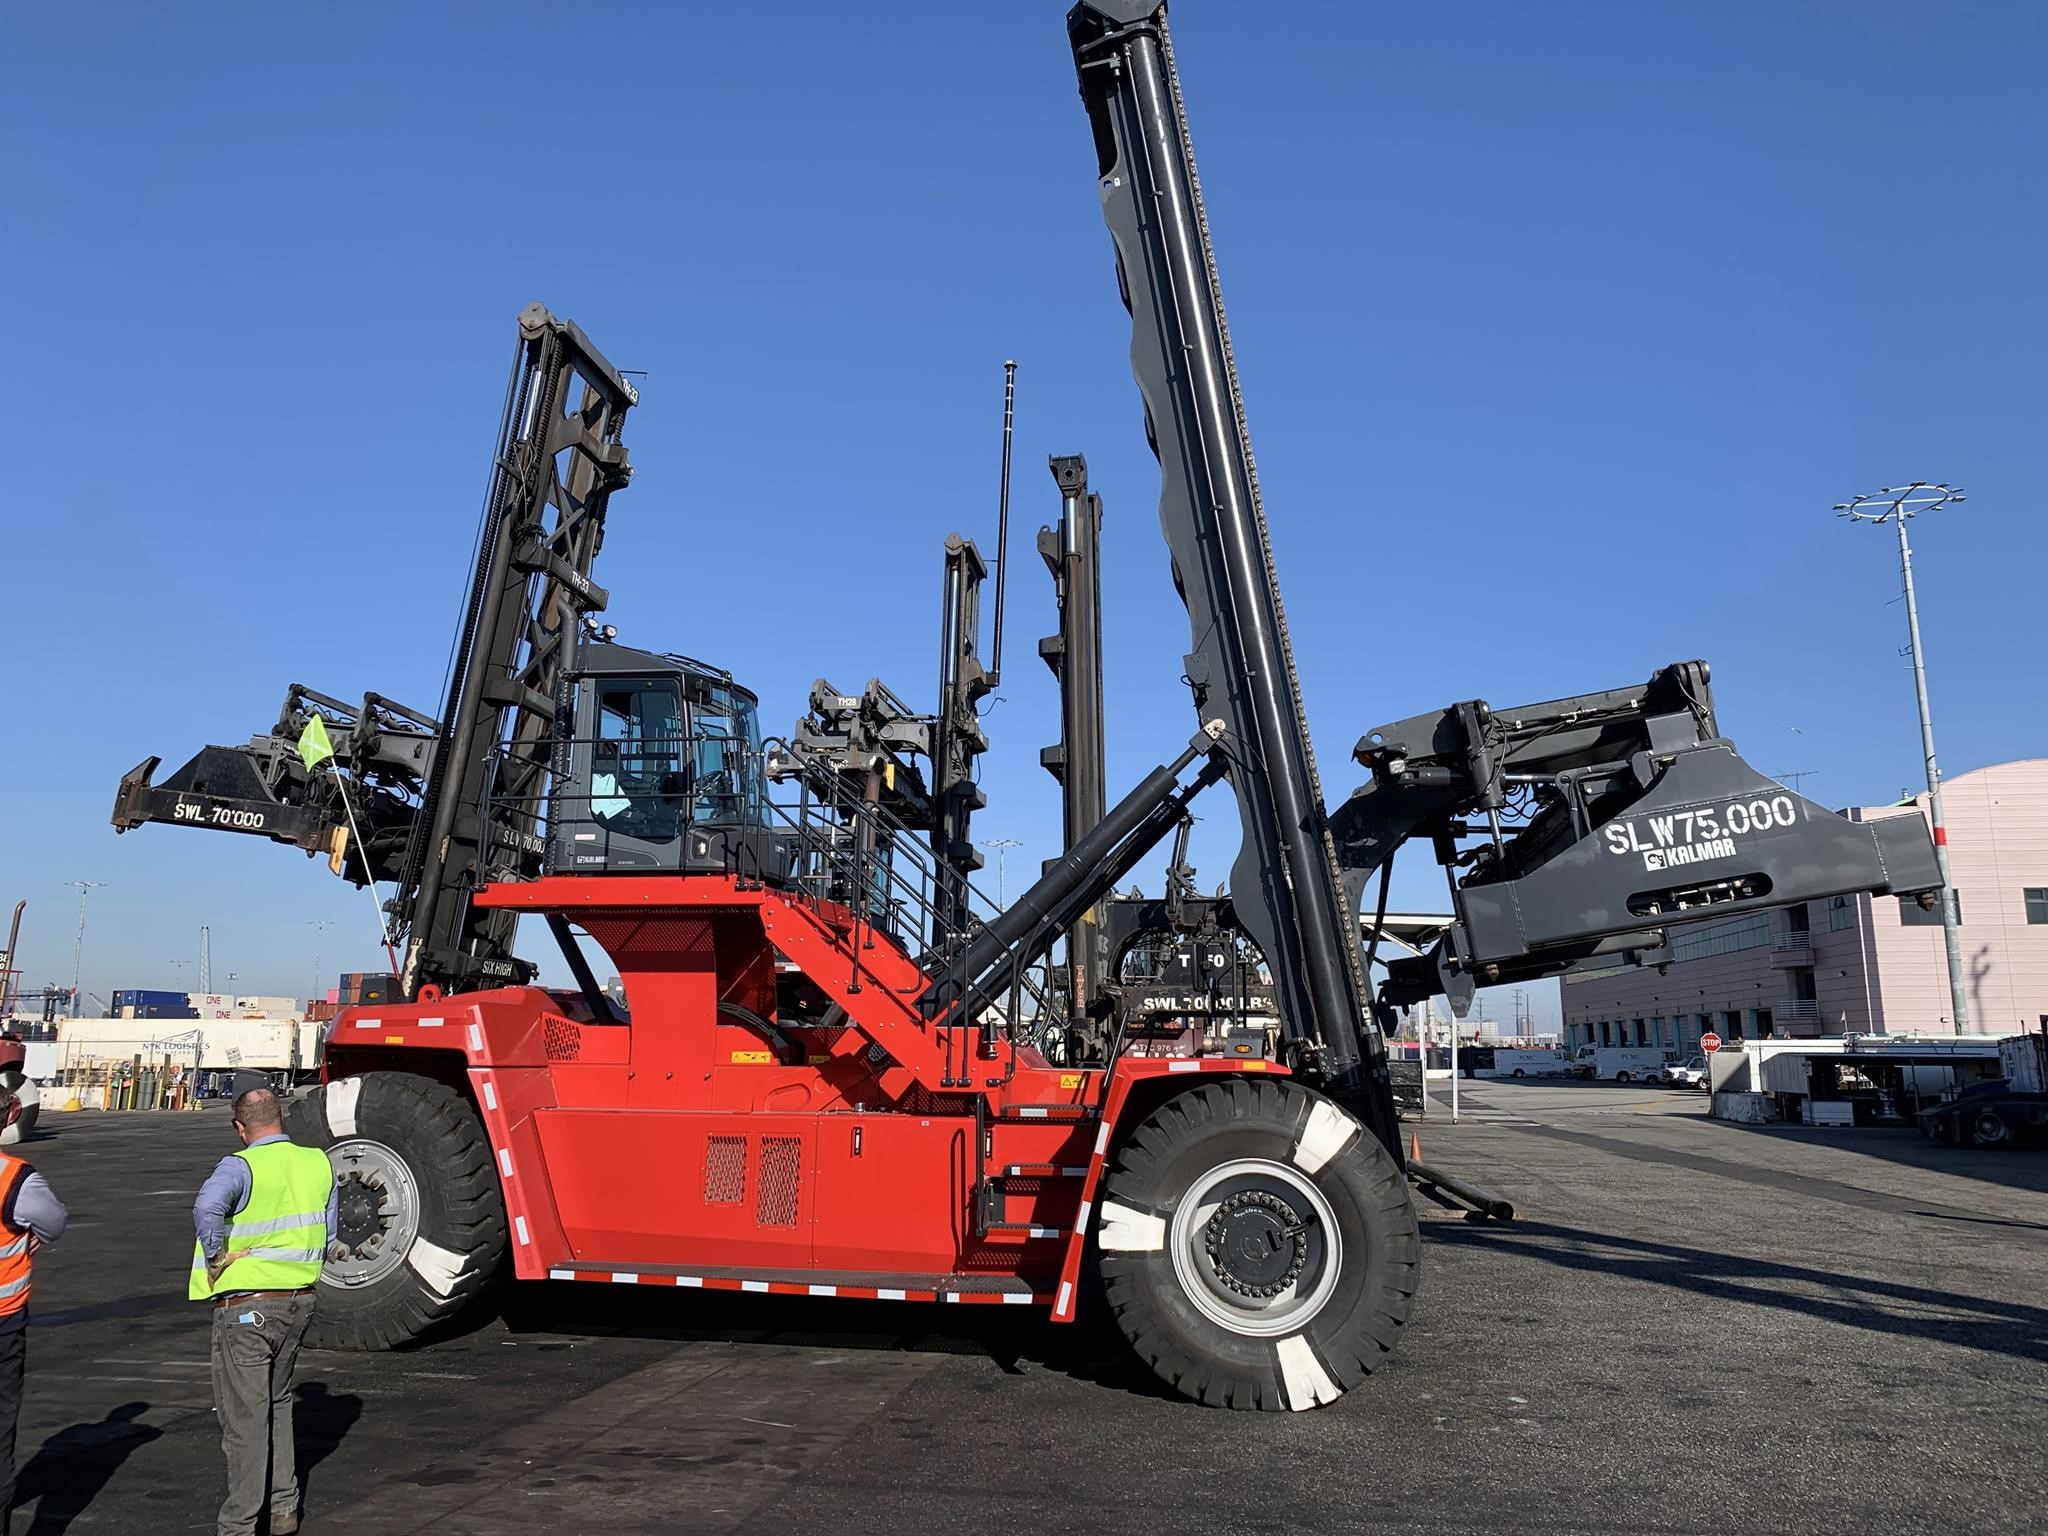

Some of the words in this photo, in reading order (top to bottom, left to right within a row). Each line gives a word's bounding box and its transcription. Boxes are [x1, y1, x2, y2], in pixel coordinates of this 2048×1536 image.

[571, 570, 590, 593] TH-33
[837, 697, 857, 707] TH28
[173, 803, 205, 821] SWL
[1665, 838, 1737, 867] KALMAR
[482, 960, 495, 975] SIX
[495, 962, 513, 977] HIGH
[1075, 964, 1085, 1009] TAYLOR
[206, 996, 221, 1005] ONE
[1143, 997, 1181, 1011] SWL
[216, 1010, 231, 1020] ONE
[1702, 1036, 1720, 1047] STOP
